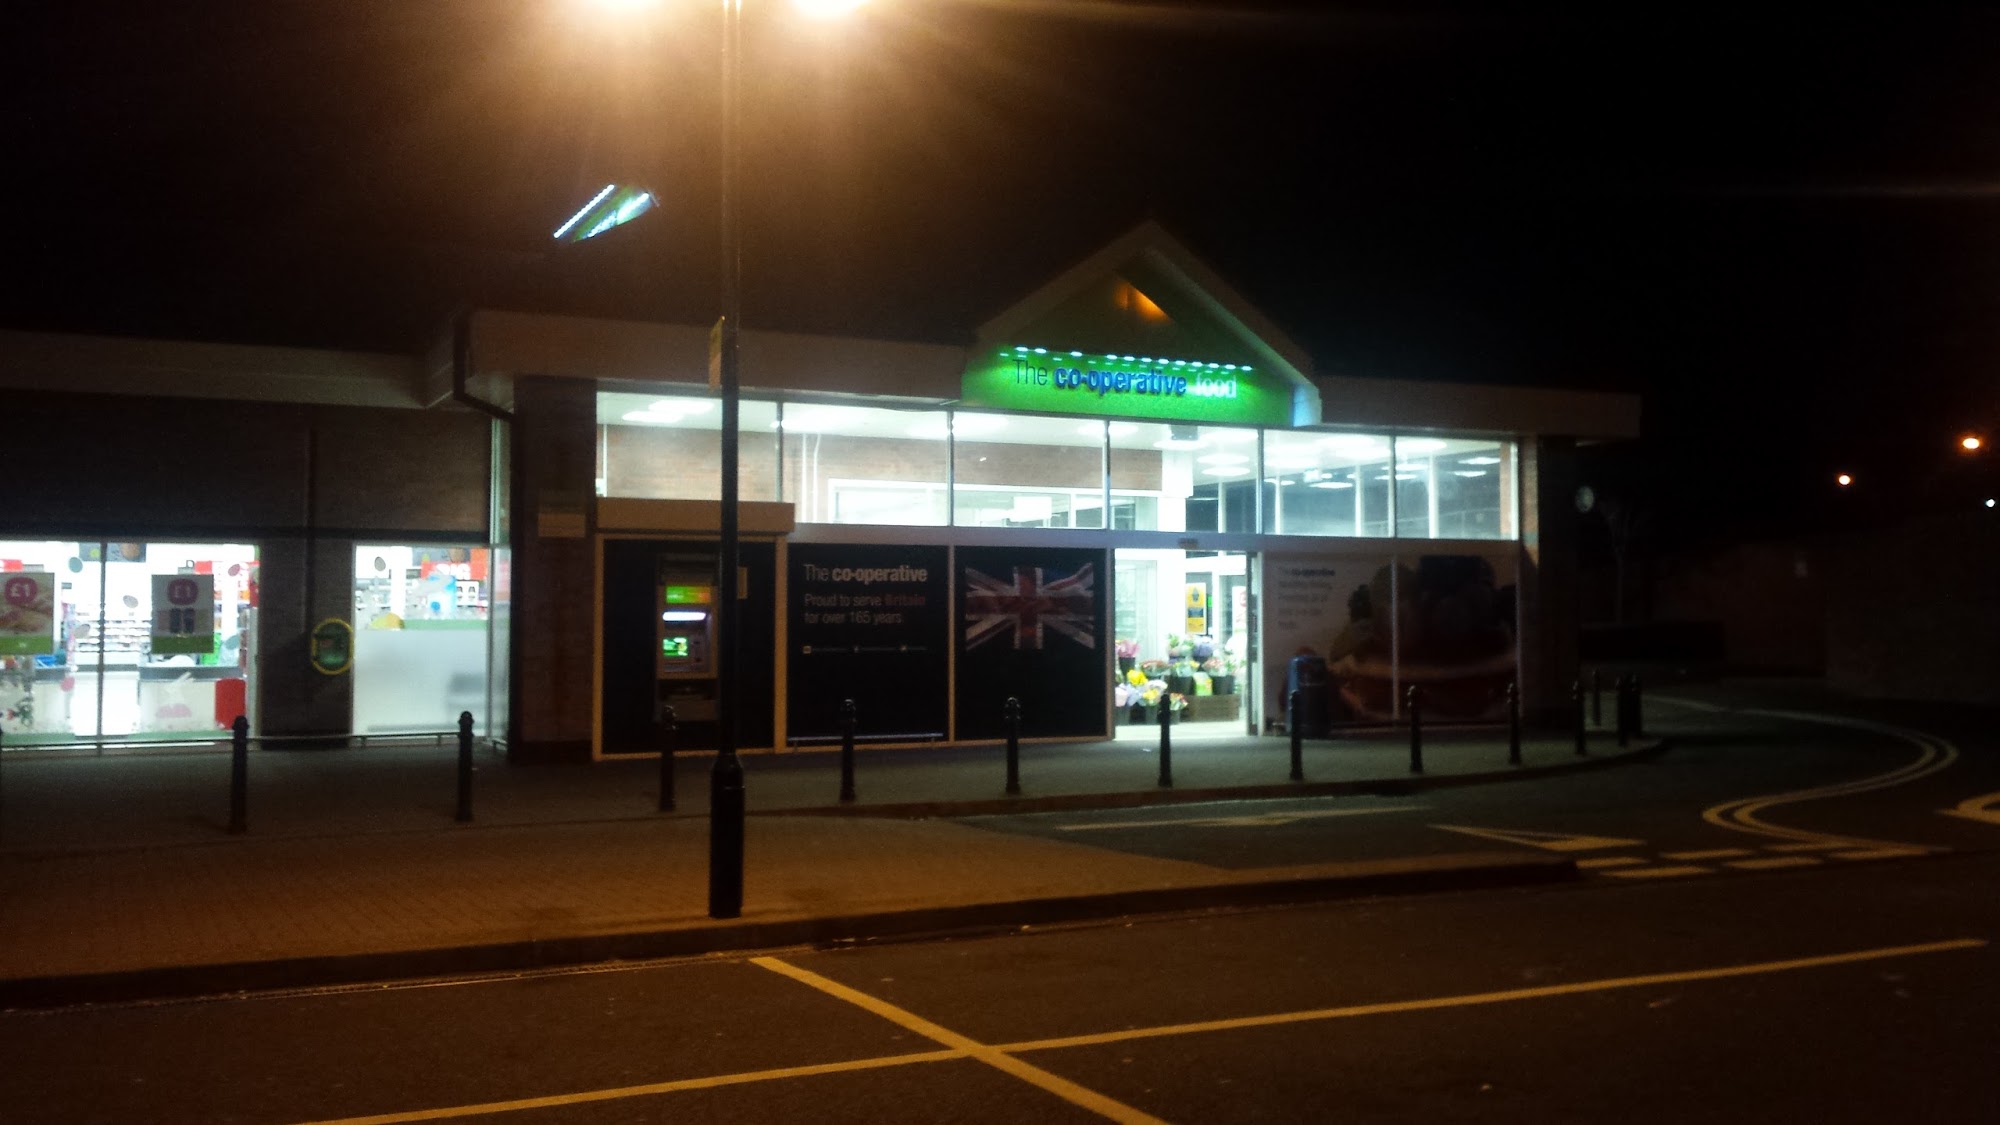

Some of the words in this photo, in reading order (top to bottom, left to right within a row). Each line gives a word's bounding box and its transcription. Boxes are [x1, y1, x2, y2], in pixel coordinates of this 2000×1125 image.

[1012, 359, 1048, 386] The
[1054, 367, 1187, 396] co-operative
[1195, 372, 1237, 398] food
[803, 564, 829, 582] The
[831, 564, 929, 586] co-operative
[804, 593, 837, 607] Proud
[839, 594, 850, 607] to
[853, 596, 882, 607] serve
[804, 611, 819, 624] for
[822, 613, 846, 624] over
[851, 610, 870, 624] 165
